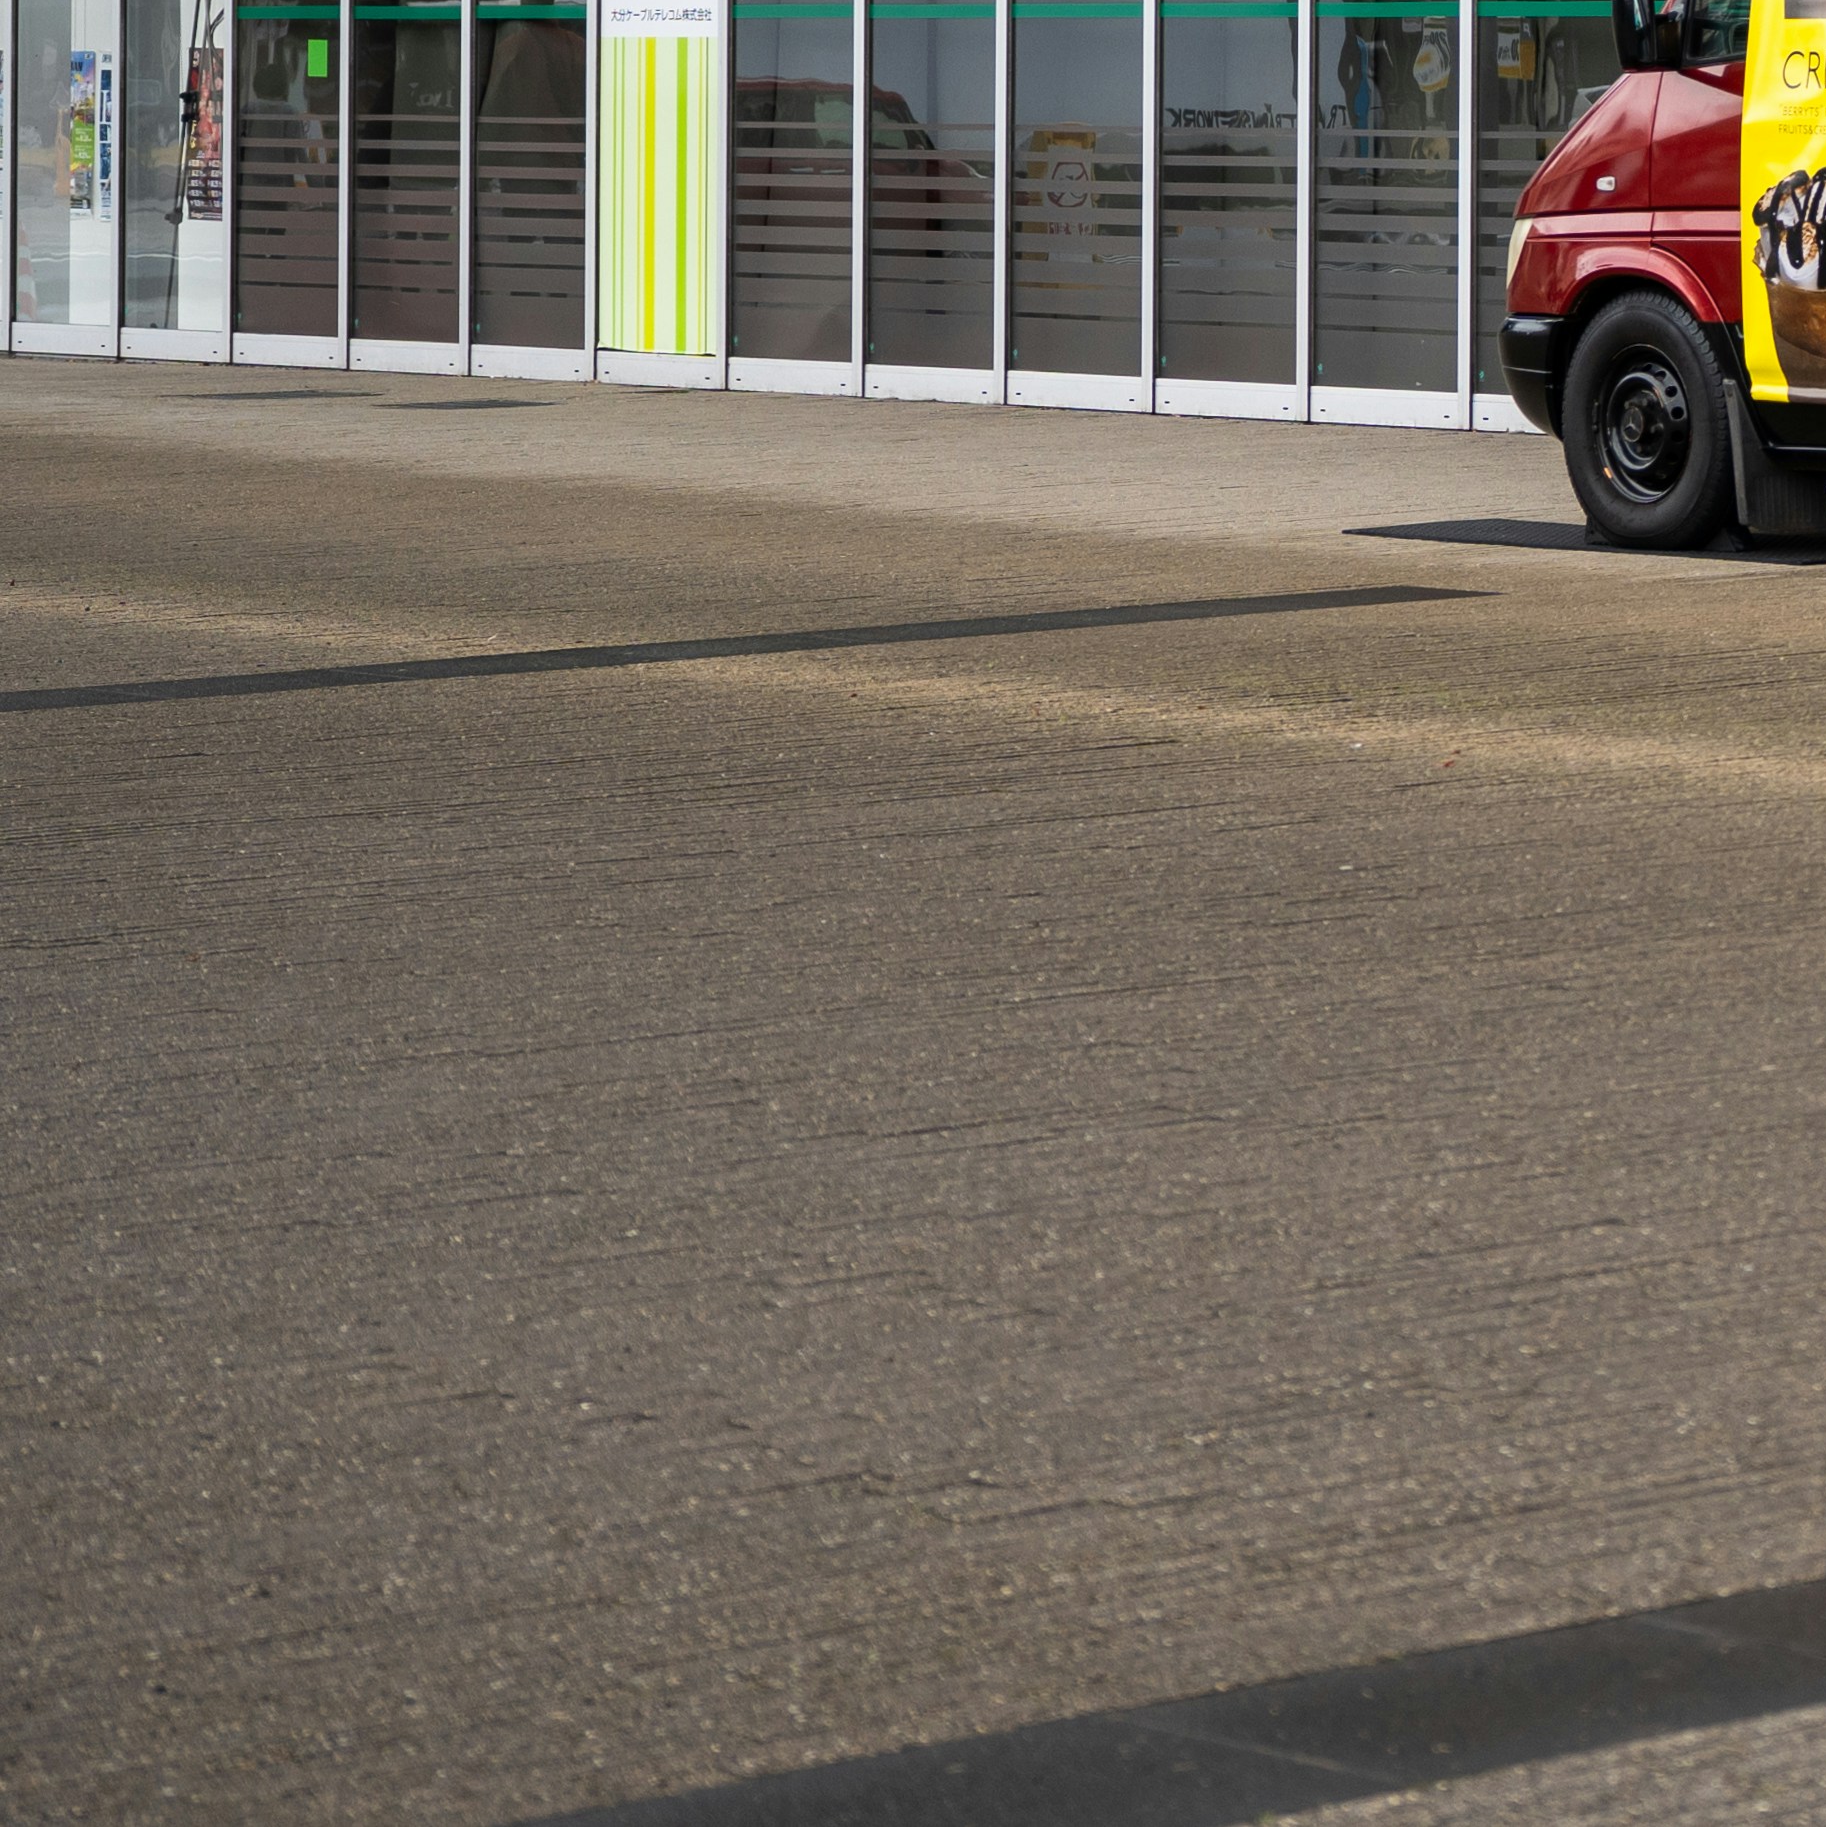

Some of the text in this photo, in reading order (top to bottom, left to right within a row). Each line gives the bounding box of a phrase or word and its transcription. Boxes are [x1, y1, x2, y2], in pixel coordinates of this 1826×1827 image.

[611, 8, 713, 23] 大分ケーブルテレコム株式会社
